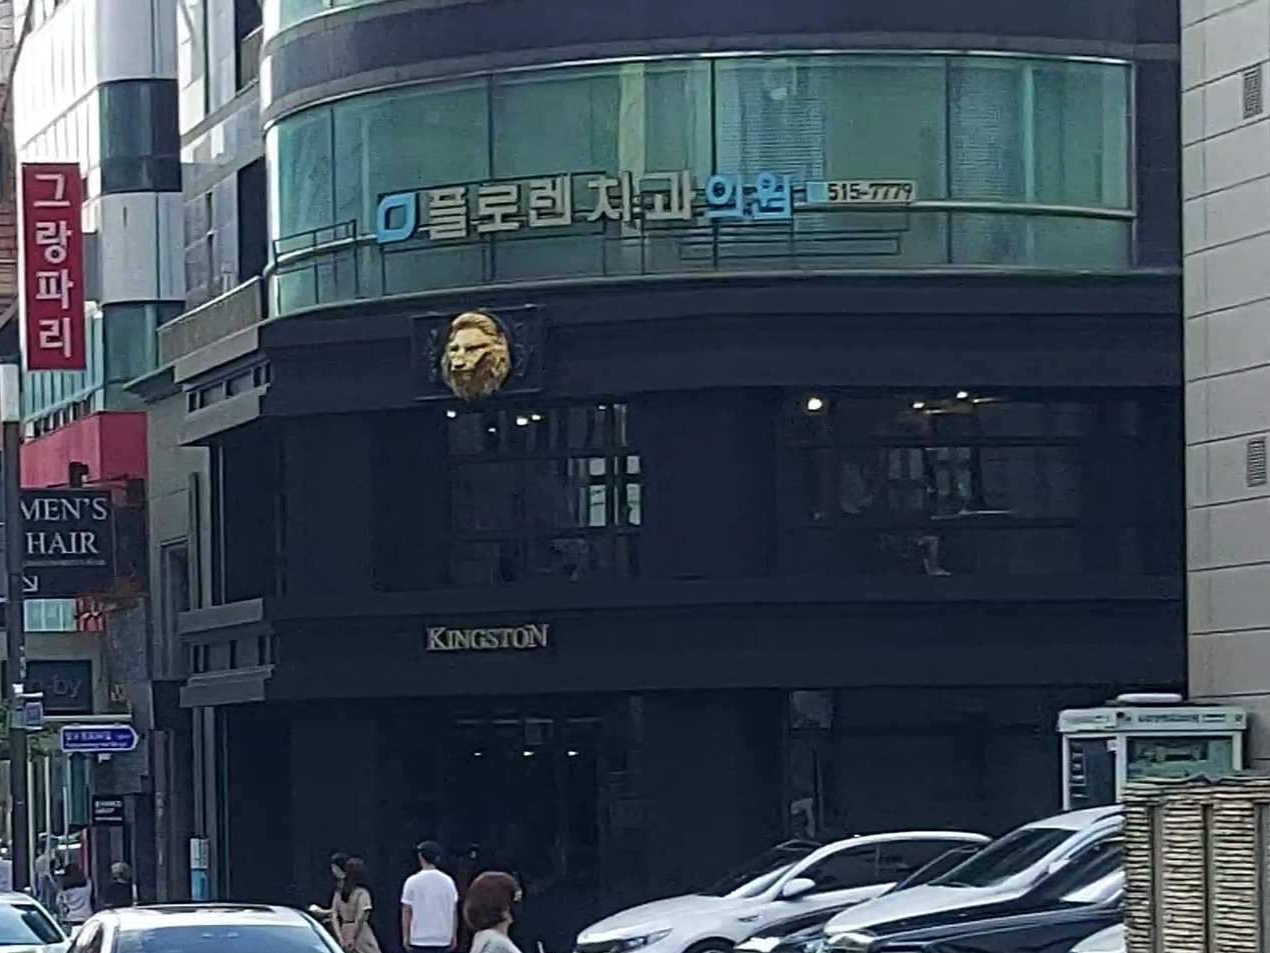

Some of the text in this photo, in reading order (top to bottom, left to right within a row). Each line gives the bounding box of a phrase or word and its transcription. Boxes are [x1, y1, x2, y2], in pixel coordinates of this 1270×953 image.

[827, 182, 913, 201] 515-7779
[20, 497, 108, 521] MEN'S
[25, 531, 100, 555] HAIR
